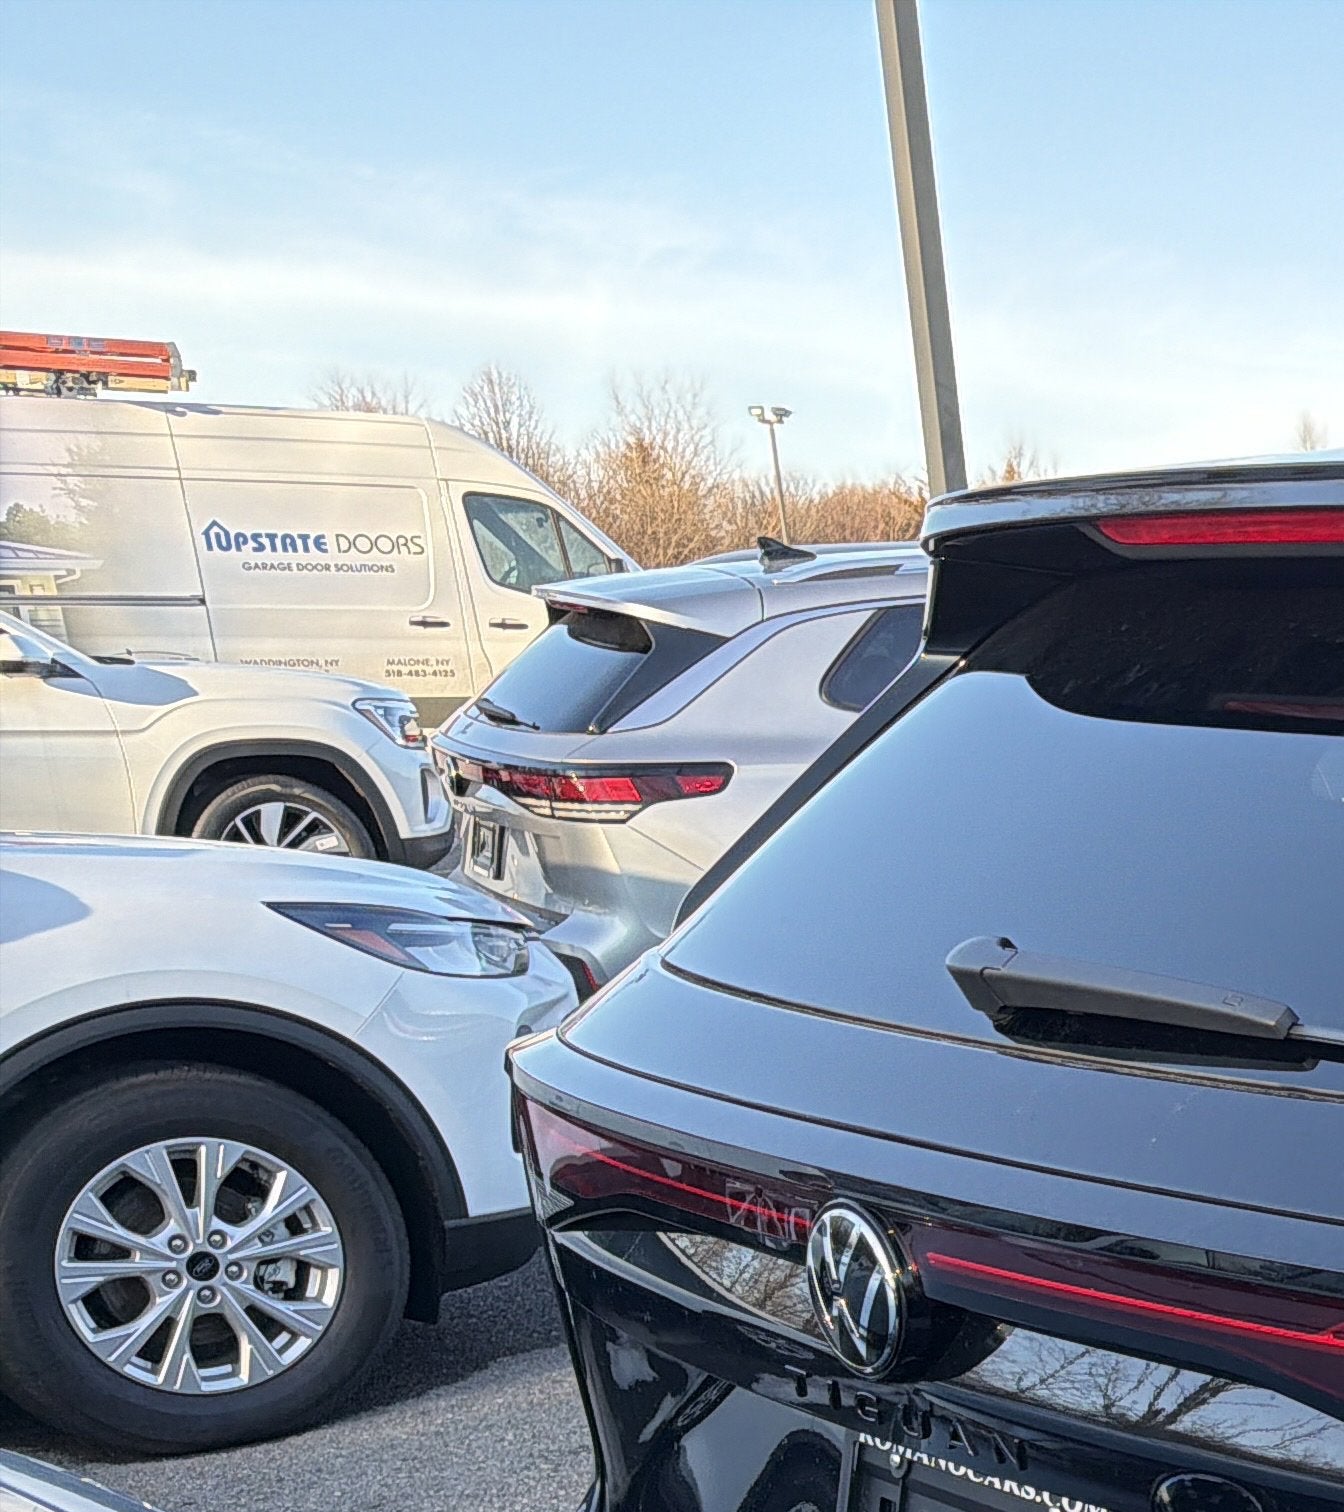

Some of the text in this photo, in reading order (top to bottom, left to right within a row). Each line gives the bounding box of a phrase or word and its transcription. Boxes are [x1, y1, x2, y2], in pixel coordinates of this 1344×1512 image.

[201, 519, 425, 555] UPSTATE DOORS
[242, 562, 396, 573] GARAGE DOOR SOLUTIONS
[436, 659, 451, 667] NY
[784, 1364, 1029, 1471] TIGUAN
